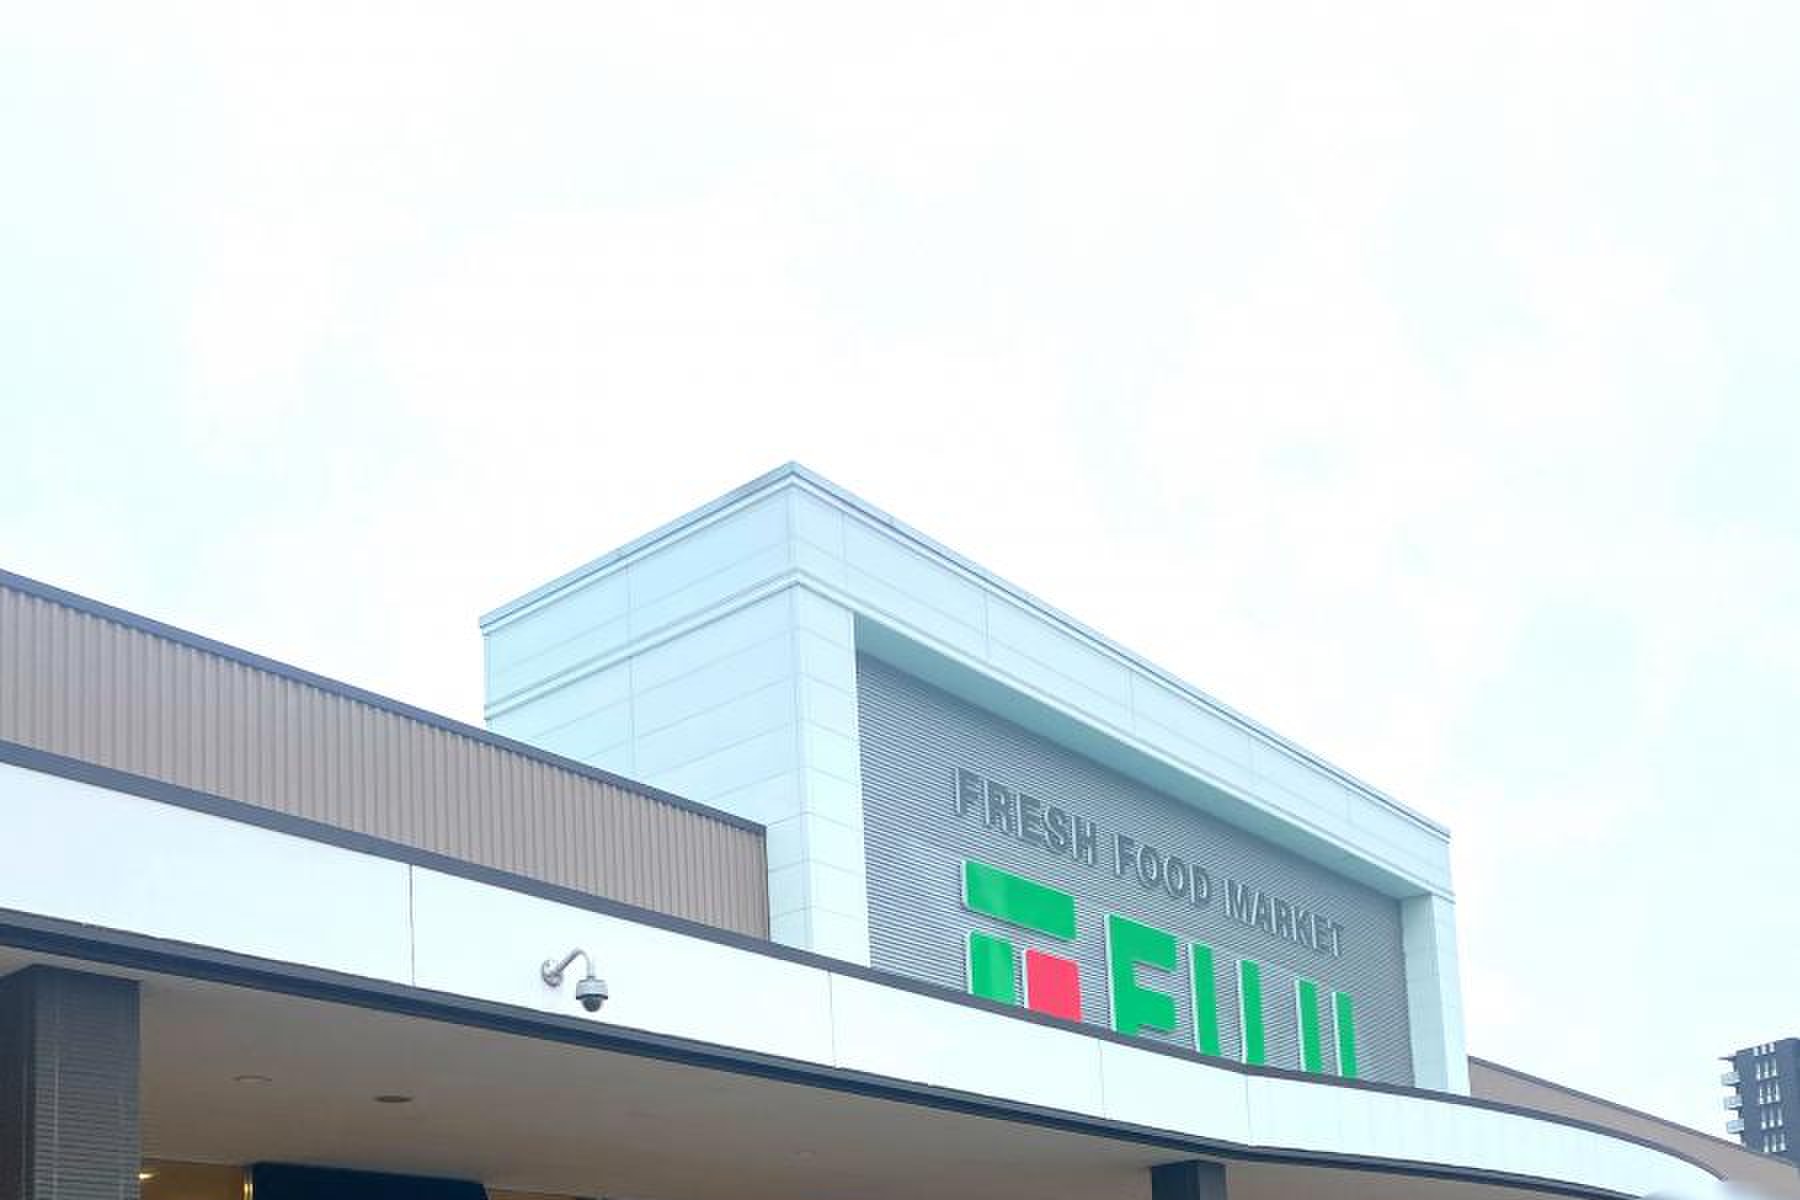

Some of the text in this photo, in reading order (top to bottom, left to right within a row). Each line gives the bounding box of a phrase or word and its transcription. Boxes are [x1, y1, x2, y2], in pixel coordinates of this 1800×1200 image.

[954, 767, 1345, 958] FRESH FOOD MARKET
